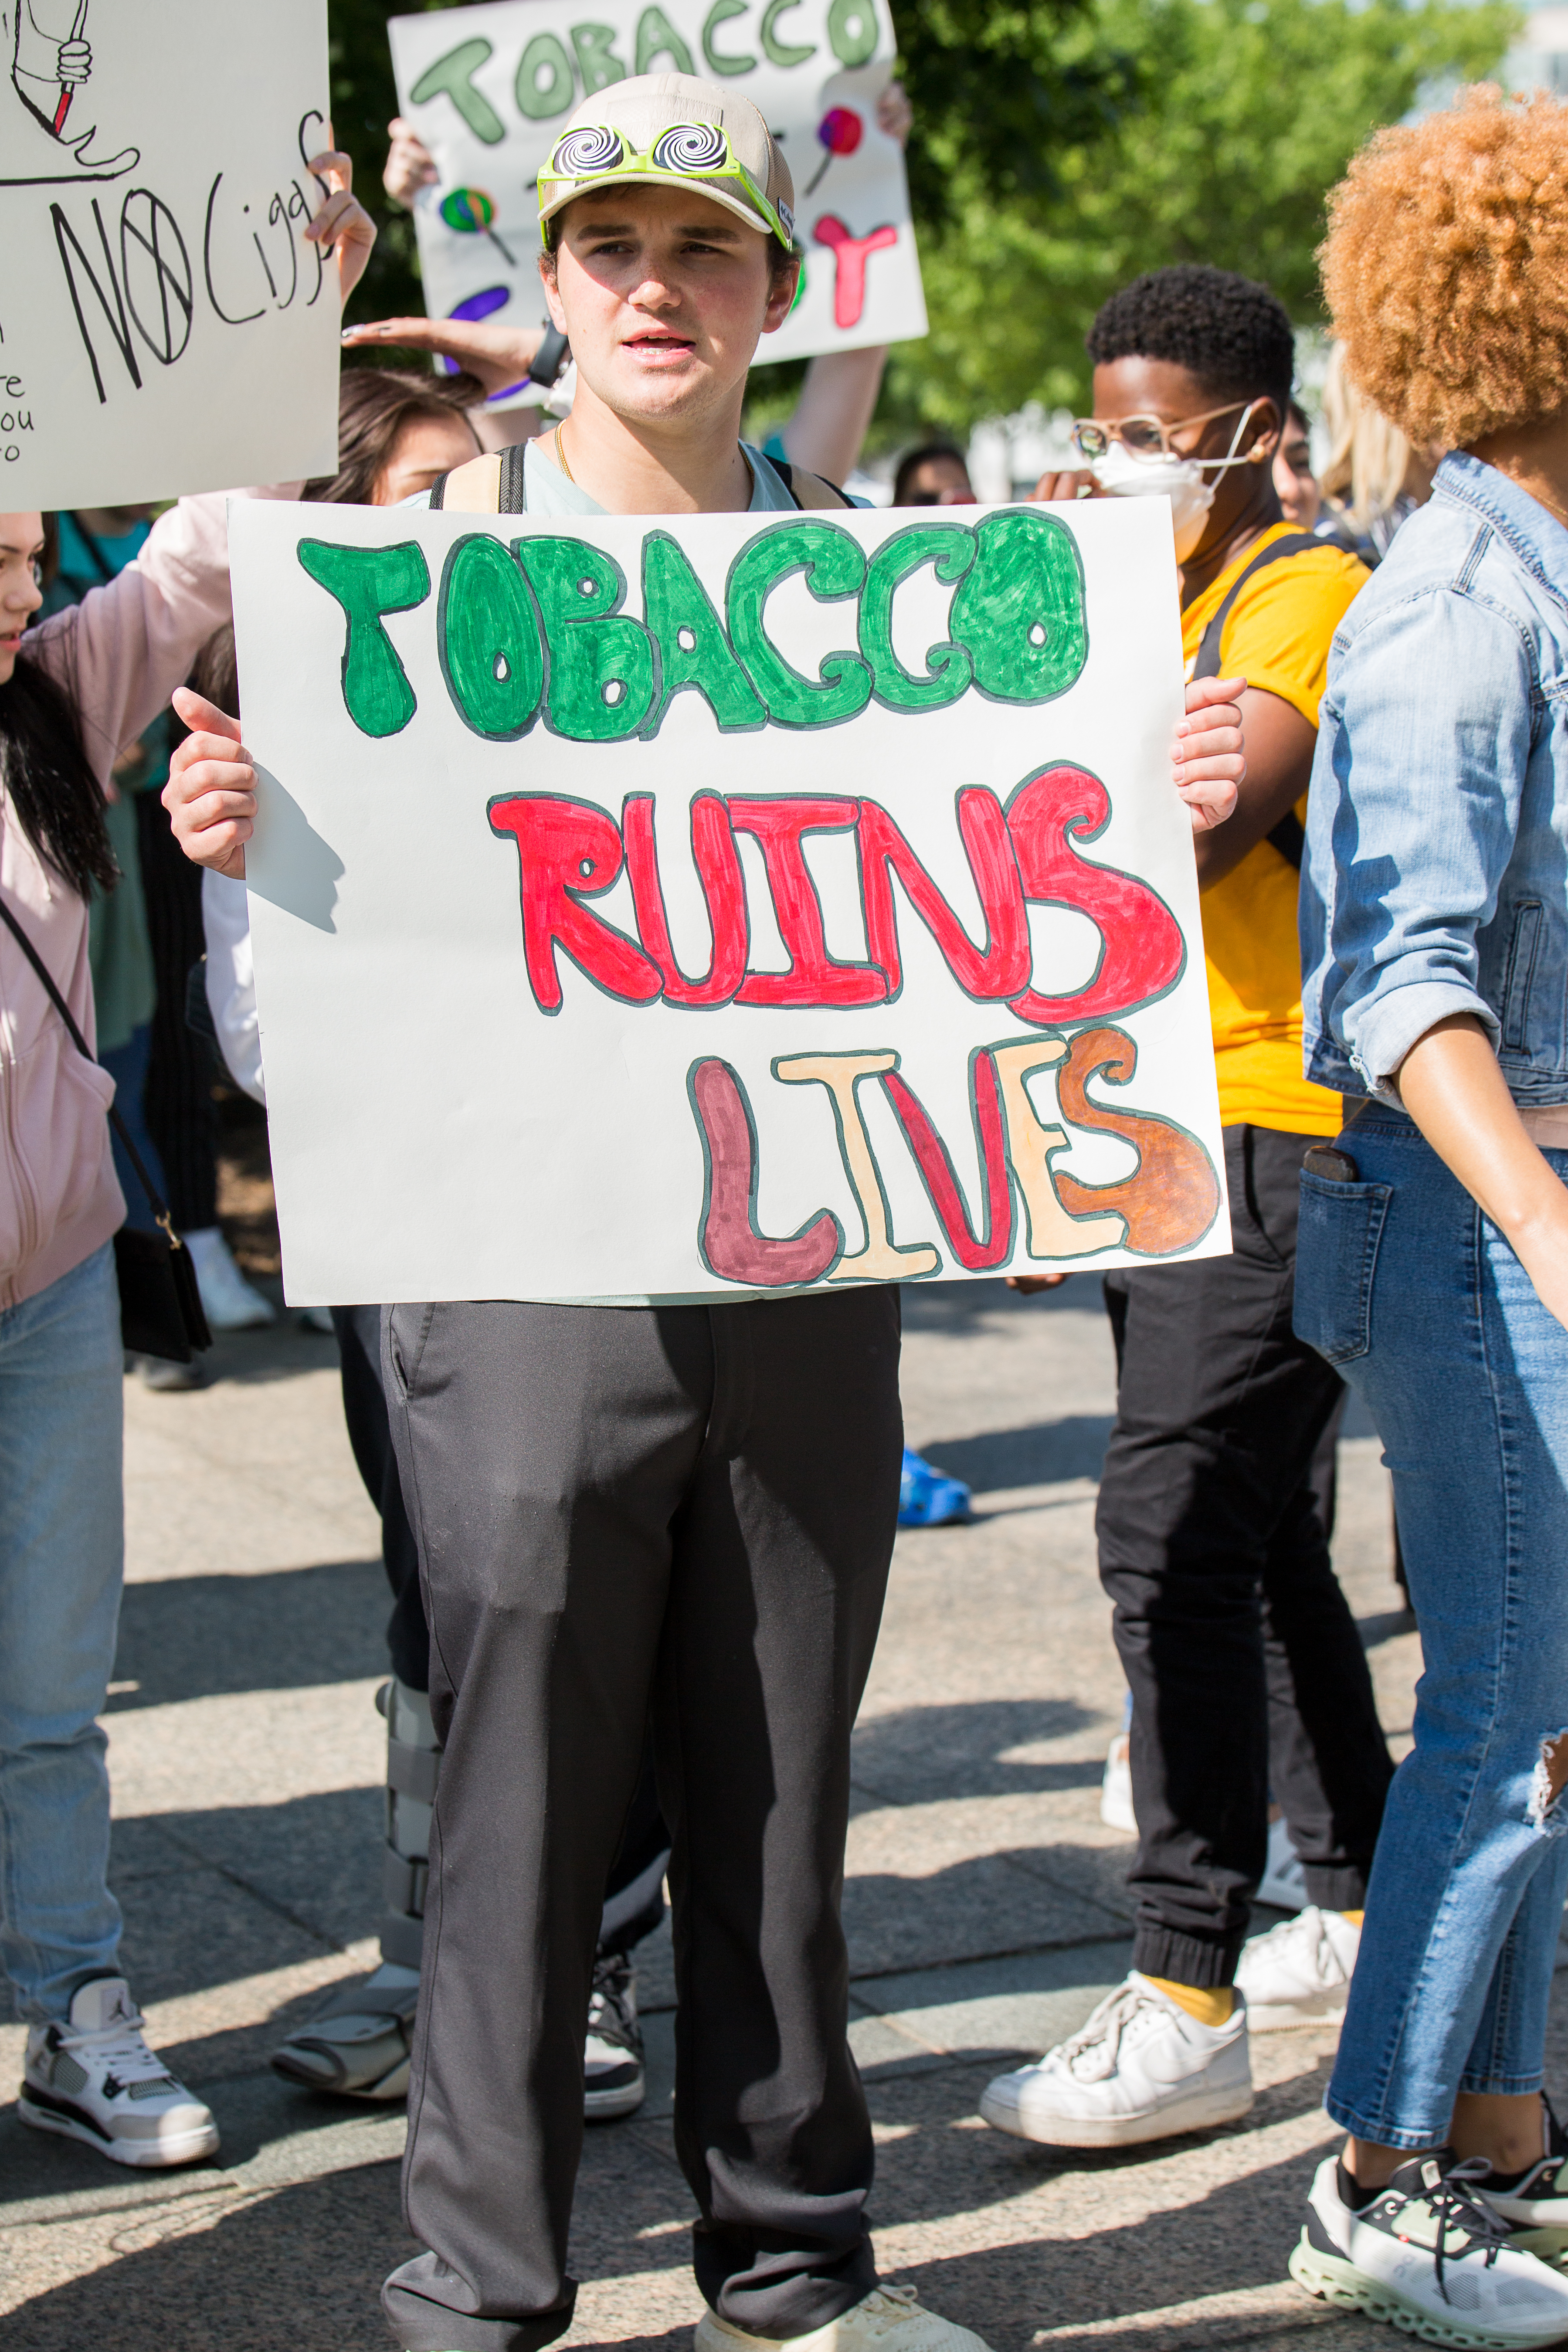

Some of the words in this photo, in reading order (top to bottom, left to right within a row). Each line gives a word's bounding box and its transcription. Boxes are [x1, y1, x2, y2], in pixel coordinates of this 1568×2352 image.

[410, 0, 879, 144] TOBACCO
[298, 508, 1088, 742] TOBACCO
[487, 760, 1186, 1032] RUINS
[686, 1023, 1220, 1286] LIVES
